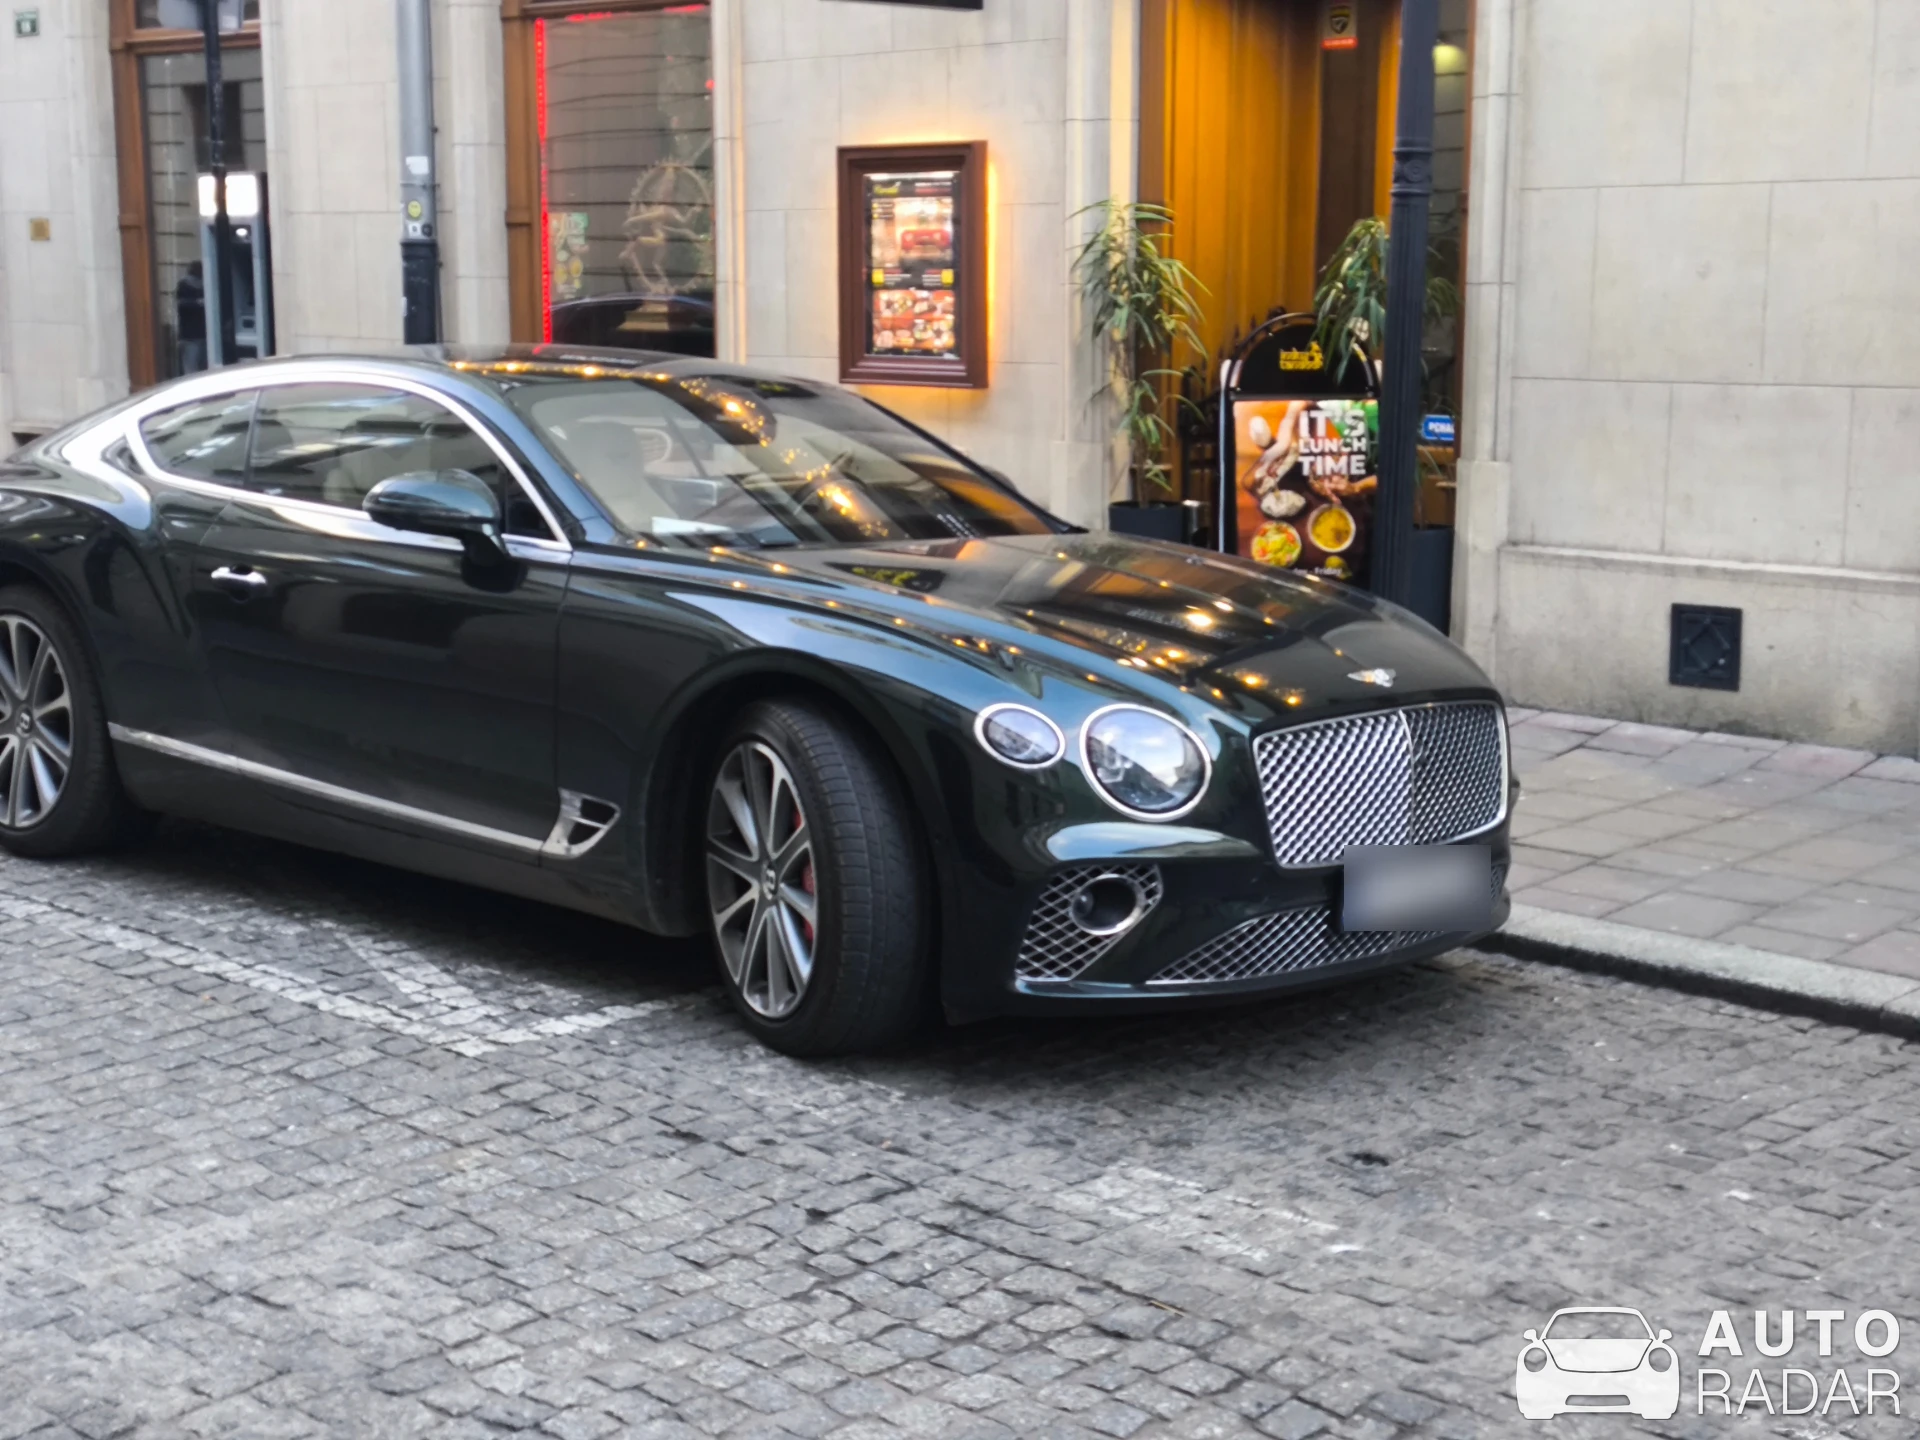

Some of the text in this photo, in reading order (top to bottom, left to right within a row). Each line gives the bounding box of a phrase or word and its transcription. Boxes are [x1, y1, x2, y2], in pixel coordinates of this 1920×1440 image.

[1299, 408, 1366, 438] IT'S
[1299, 437, 1367, 453] LUNCH
[1298, 454, 1367, 476] TIME
